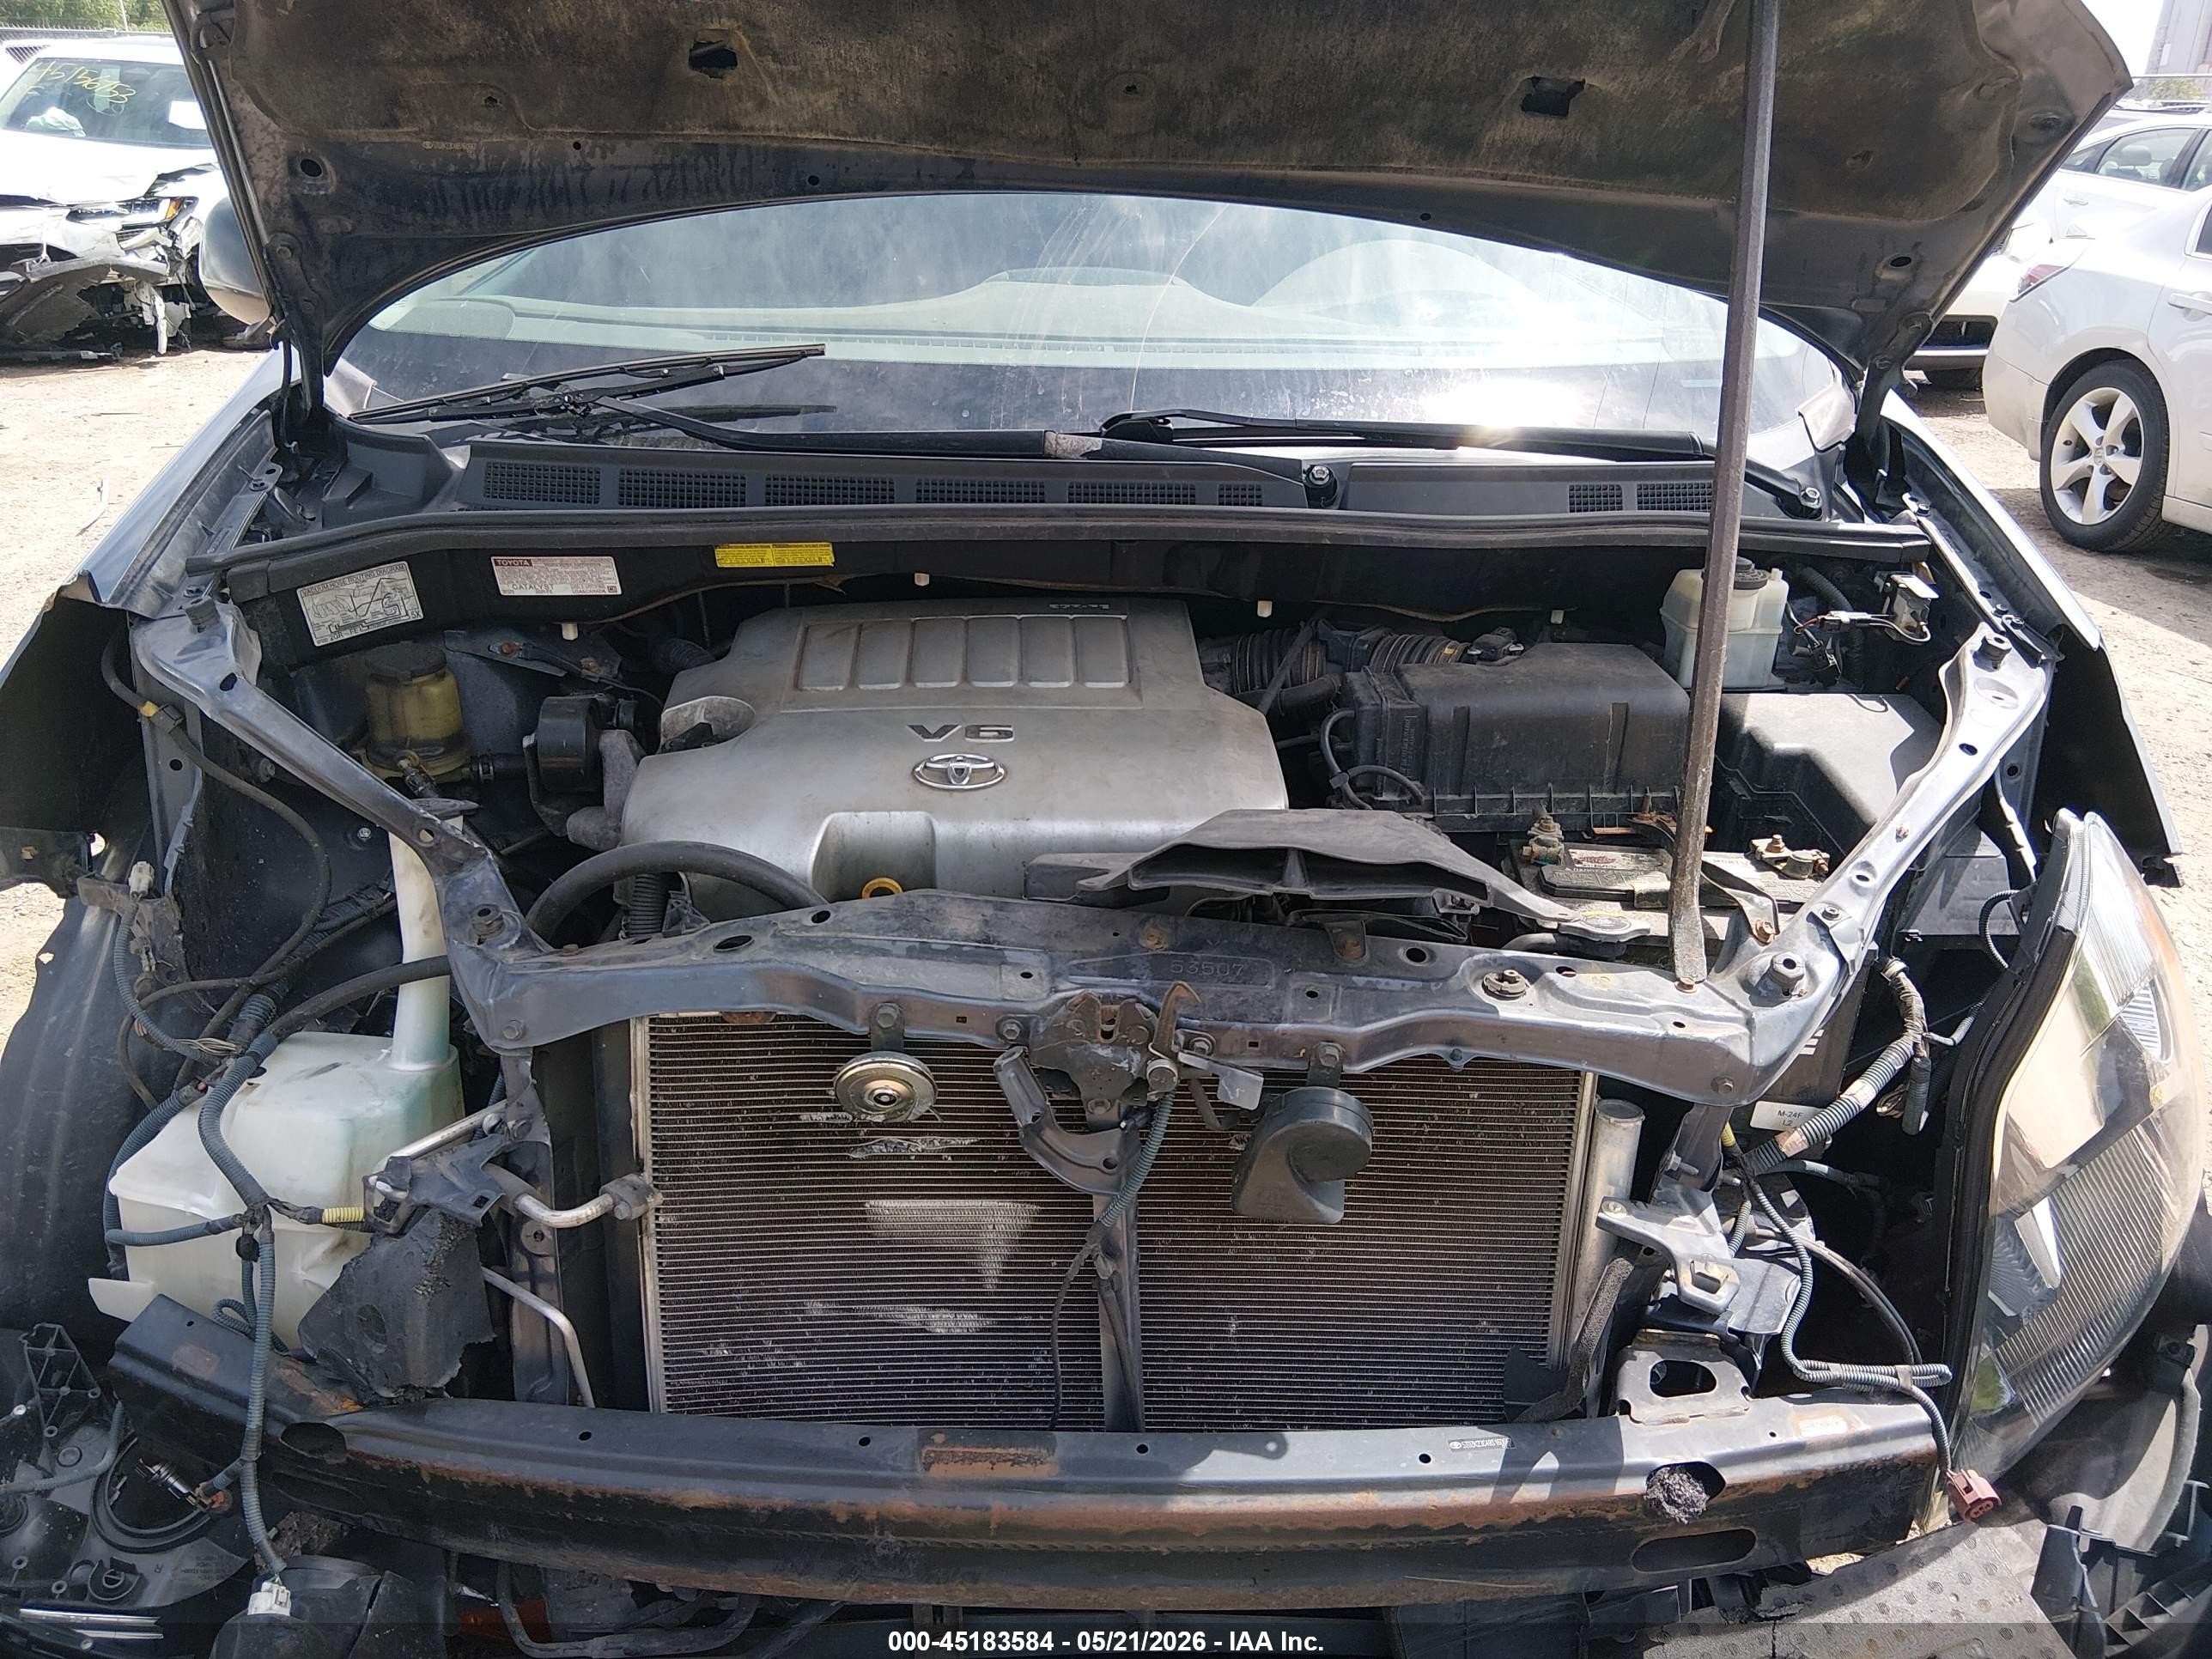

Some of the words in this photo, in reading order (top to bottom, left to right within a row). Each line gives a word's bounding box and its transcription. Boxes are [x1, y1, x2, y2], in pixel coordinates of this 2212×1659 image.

[301, 584, 330, 597] VACUUM
[348, 570, 376, 584] ROUTING
[376, 564, 405, 575] DIAGRAM
[411, 610, 422, 619] 5X
[907, 724, 1015, 743] V6
